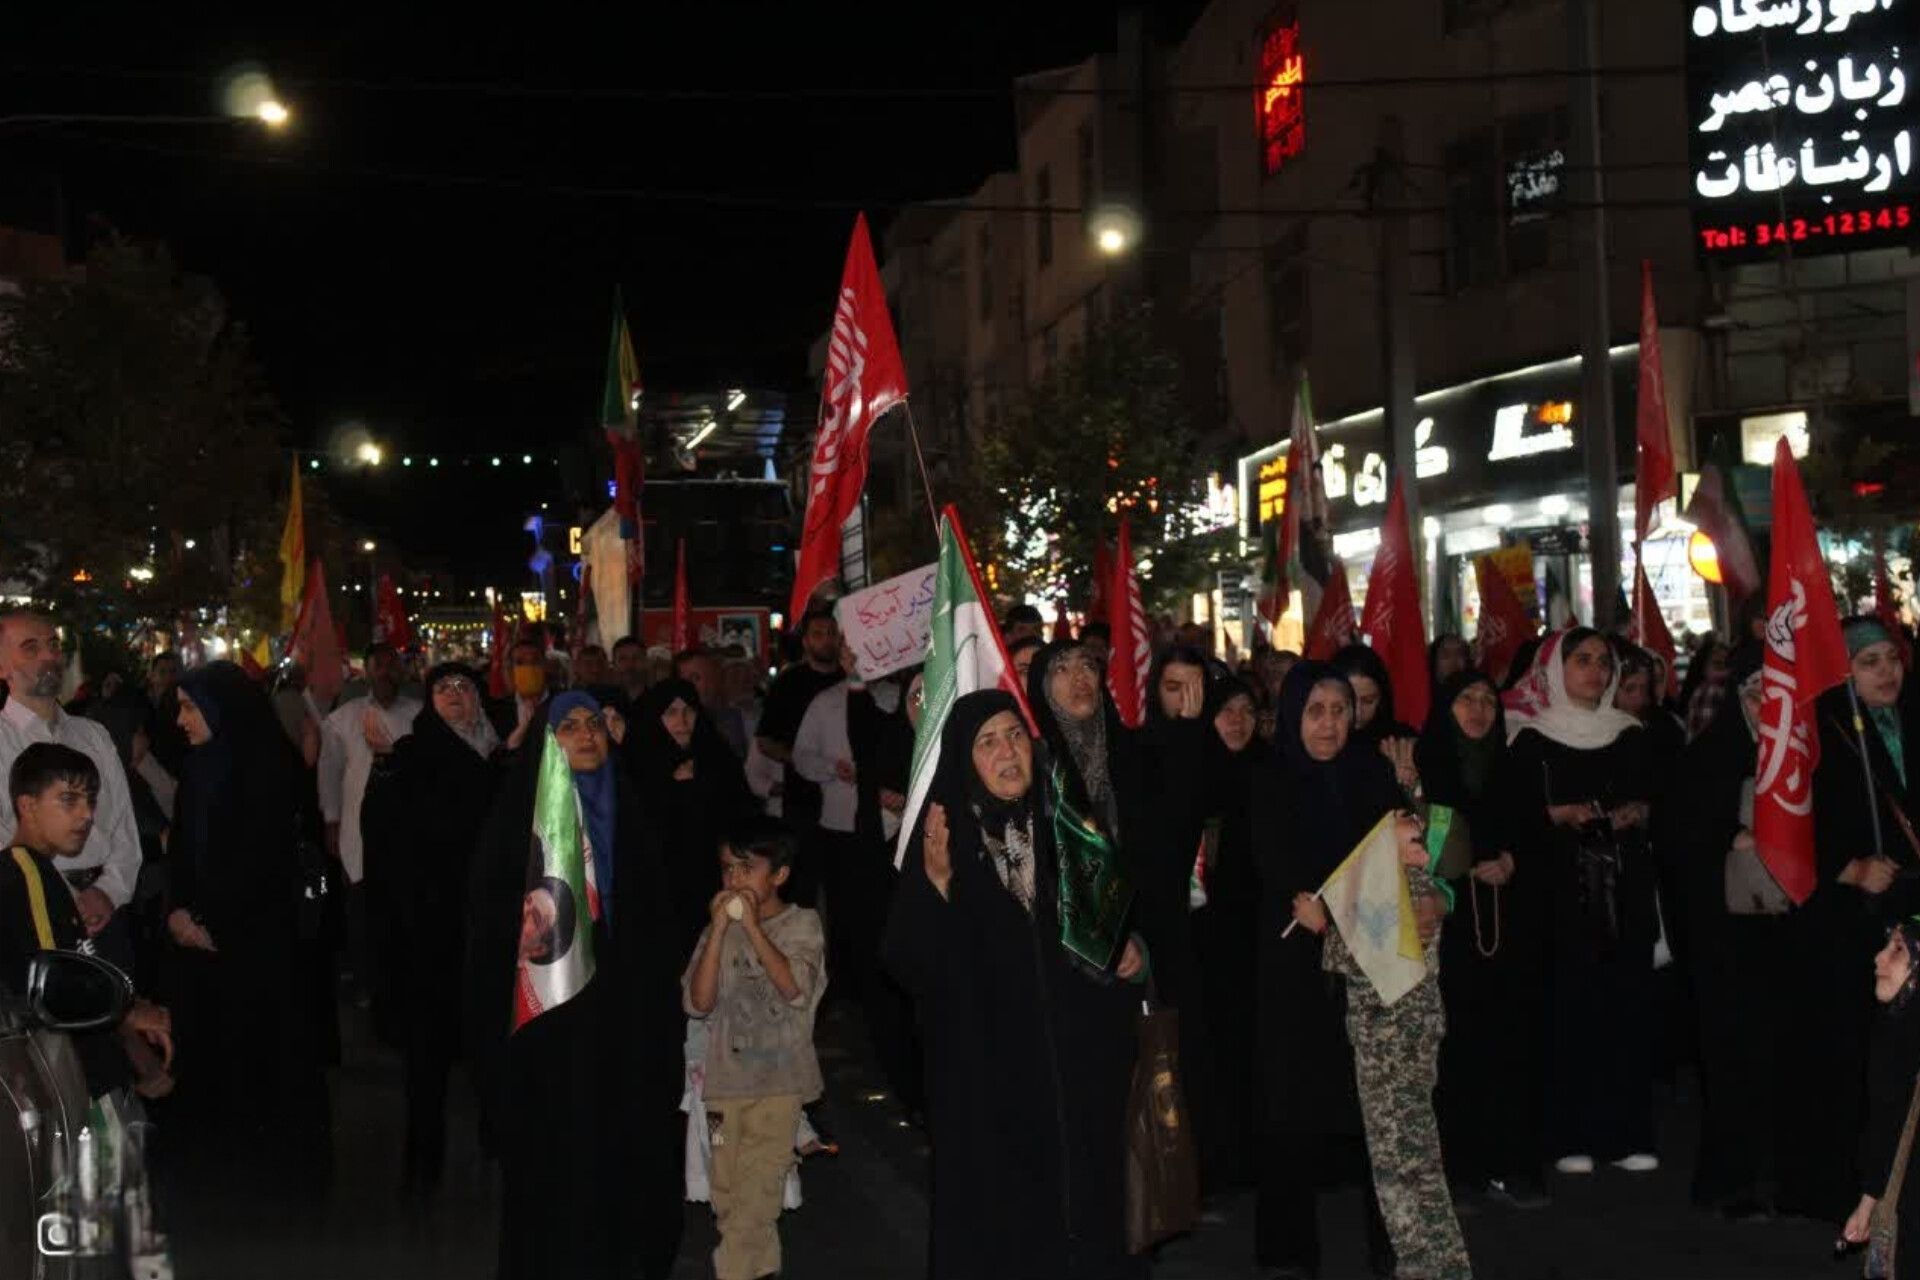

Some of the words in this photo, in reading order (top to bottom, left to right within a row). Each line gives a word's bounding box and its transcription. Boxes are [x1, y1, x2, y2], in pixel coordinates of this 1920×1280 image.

[1699, 74, 1791, 132] عصر
[1796, 46, 1906, 121] زبان
[1697, 130, 1911, 204] ارتباطات
[1702, 226, 1746, 249] Tel:
[1755, 205, 1911, 245] 342-12345
